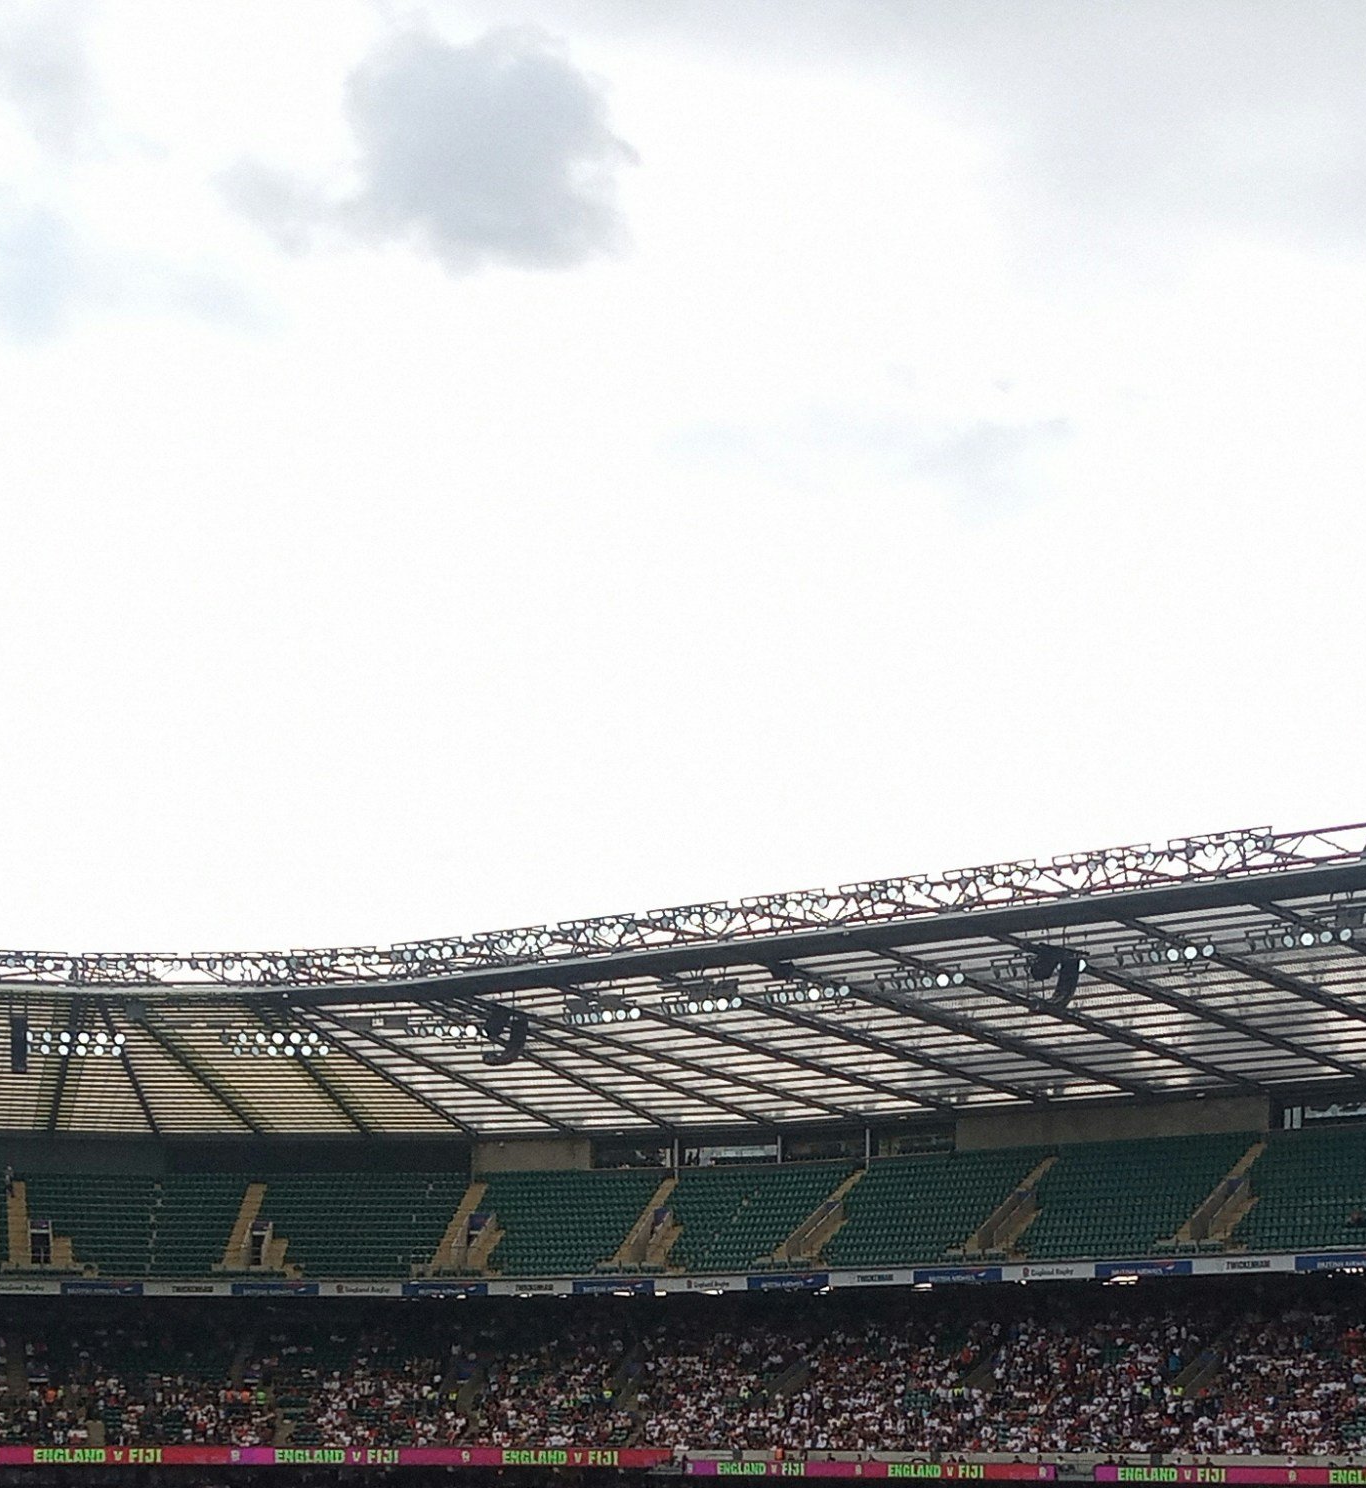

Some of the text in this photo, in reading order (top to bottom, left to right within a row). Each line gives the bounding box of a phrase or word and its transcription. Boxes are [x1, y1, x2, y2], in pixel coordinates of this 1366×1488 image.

[33, 1448, 106, 1463] ENGLAND
[128, 1448, 162, 1463] FIJI
[274, 1449, 345, 1464] ENGLAND
[366, 1449, 399, 1464] FIJI
[502, 1450, 567, 1465] ENGLAND
[588, 1450, 619, 1466] FIJI
[716, 1462, 766, 1476] ENGLAND
[781, 1463, 805, 1476] FIJI
[887, 1464, 942, 1478] ENGLAND
[958, 1465, 984, 1479] FIJI
[1117, 1467, 1178, 1482] ENGLAND
[1197, 1468, 1226, 1483] FIJI
